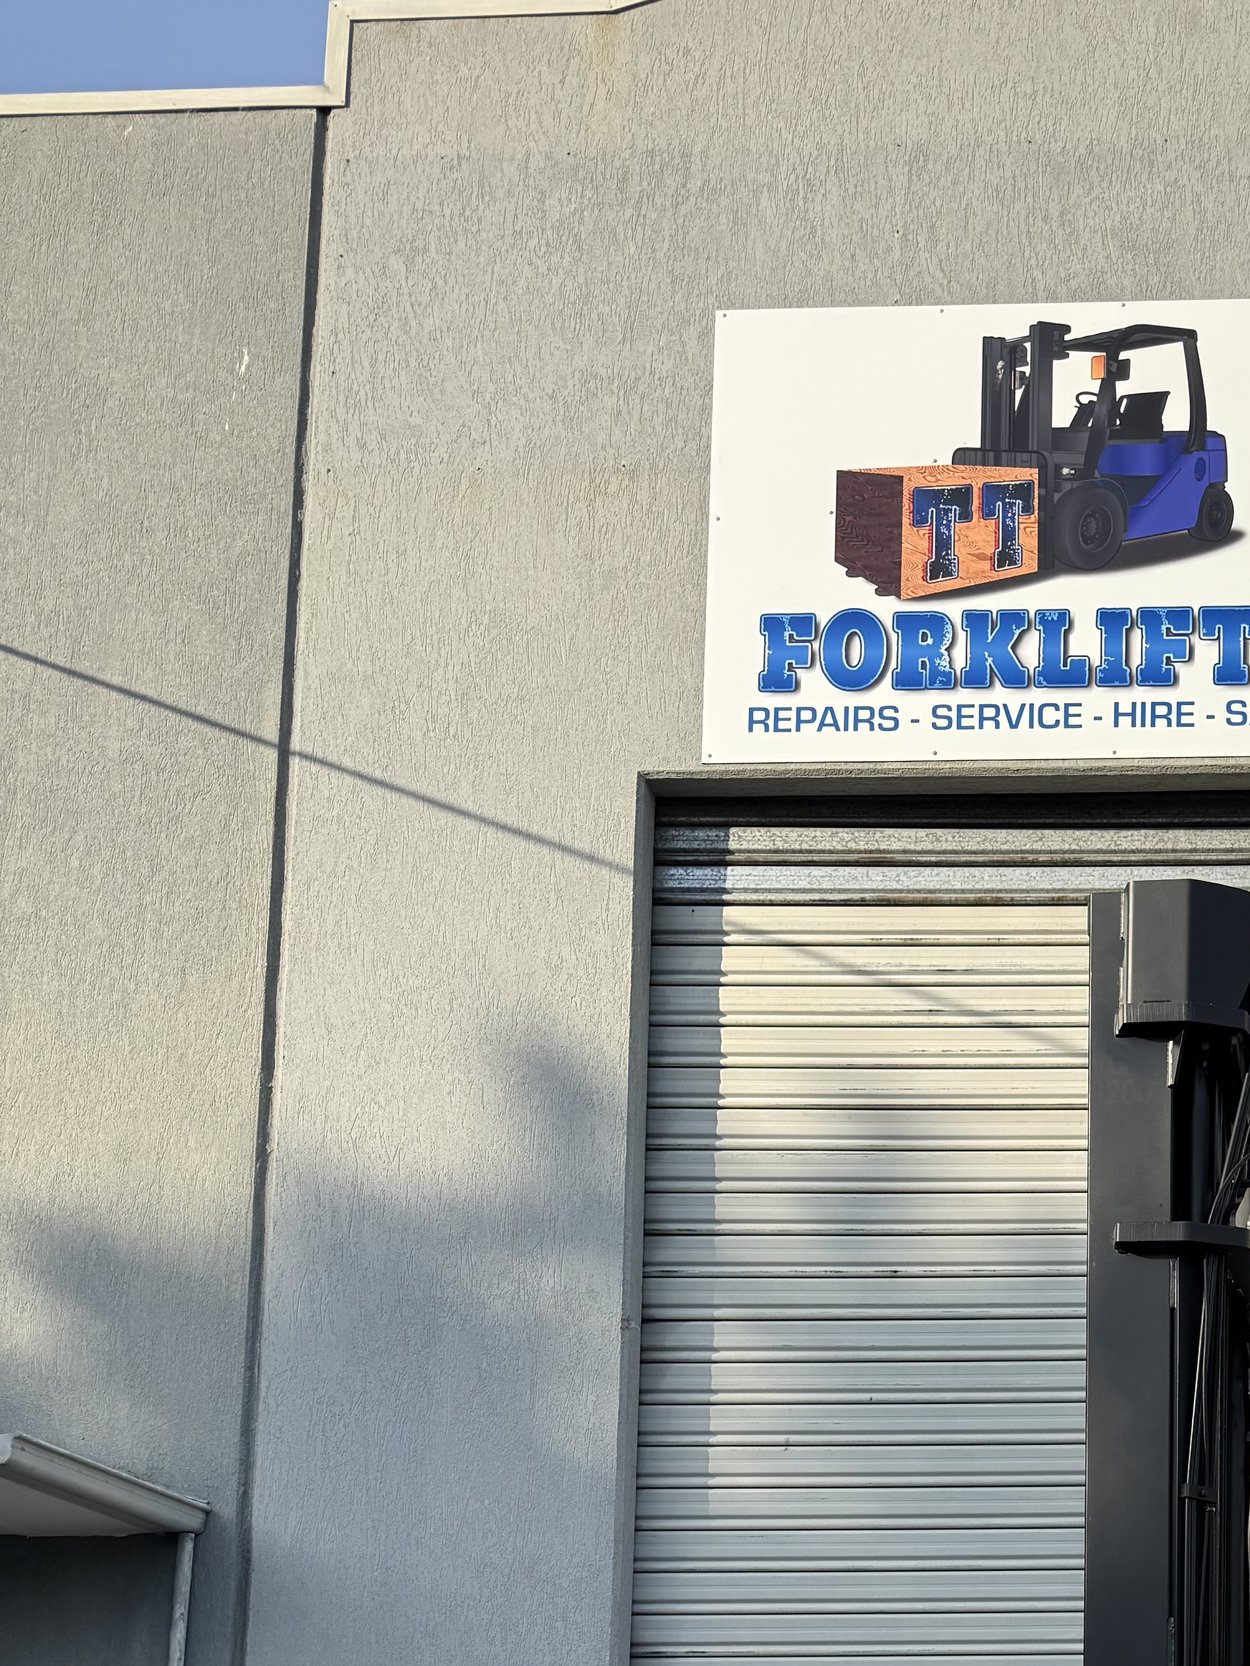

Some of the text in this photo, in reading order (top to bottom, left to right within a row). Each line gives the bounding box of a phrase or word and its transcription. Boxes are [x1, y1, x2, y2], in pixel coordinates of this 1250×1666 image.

[912, 480, 1035, 583] TT
[748, 706, 899, 732] REPAIRS
[932, 703, 1082, 730] SERVICE
[1114, 701, 1195, 727] HIRE
